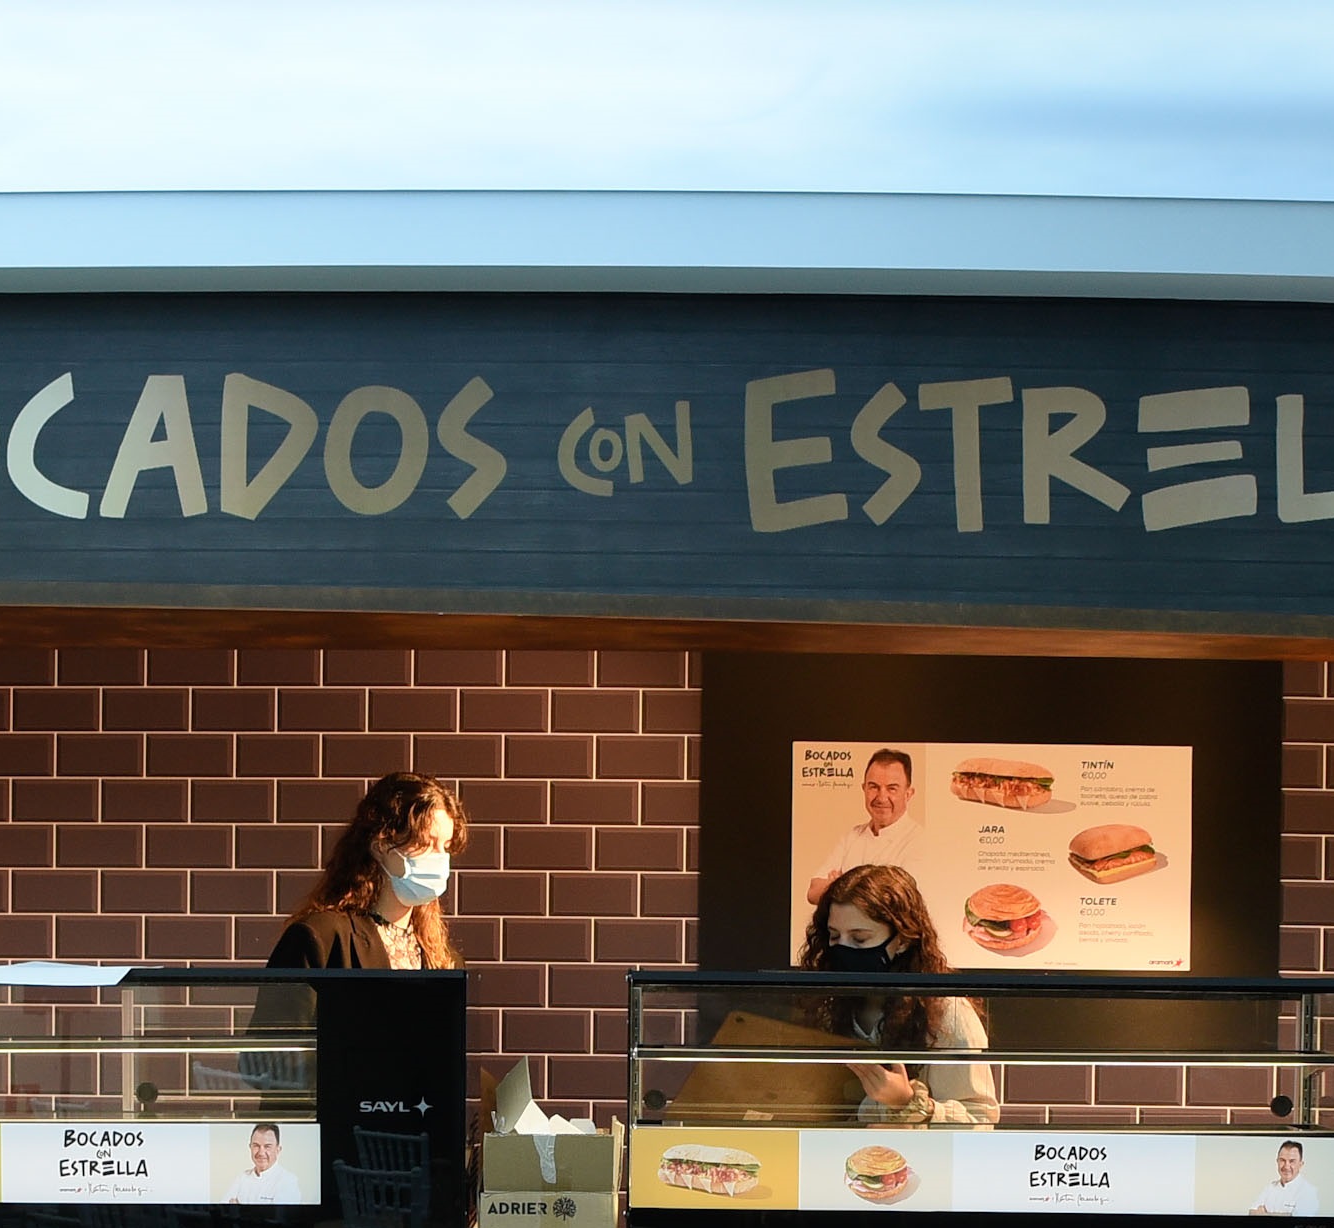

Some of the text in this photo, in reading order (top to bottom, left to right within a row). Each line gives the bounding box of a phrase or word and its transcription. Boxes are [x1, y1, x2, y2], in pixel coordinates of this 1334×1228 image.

[805, 749, 851, 761] BOCADOS
[802, 767, 854, 778] ESTRELLA
[978, 825, 1005, 834] JARA
[1079, 897, 1117, 906] TOLETE
[359, 1101, 410, 1113] SAYL
[64, 1129, 144, 1148] BOCADOS
[1035, 1144, 1107, 1161] BOCADOS
[59, 1159, 148, 1177] ESTRELLA
[1030, 1171, 1110, 1188] ESTRELLA
